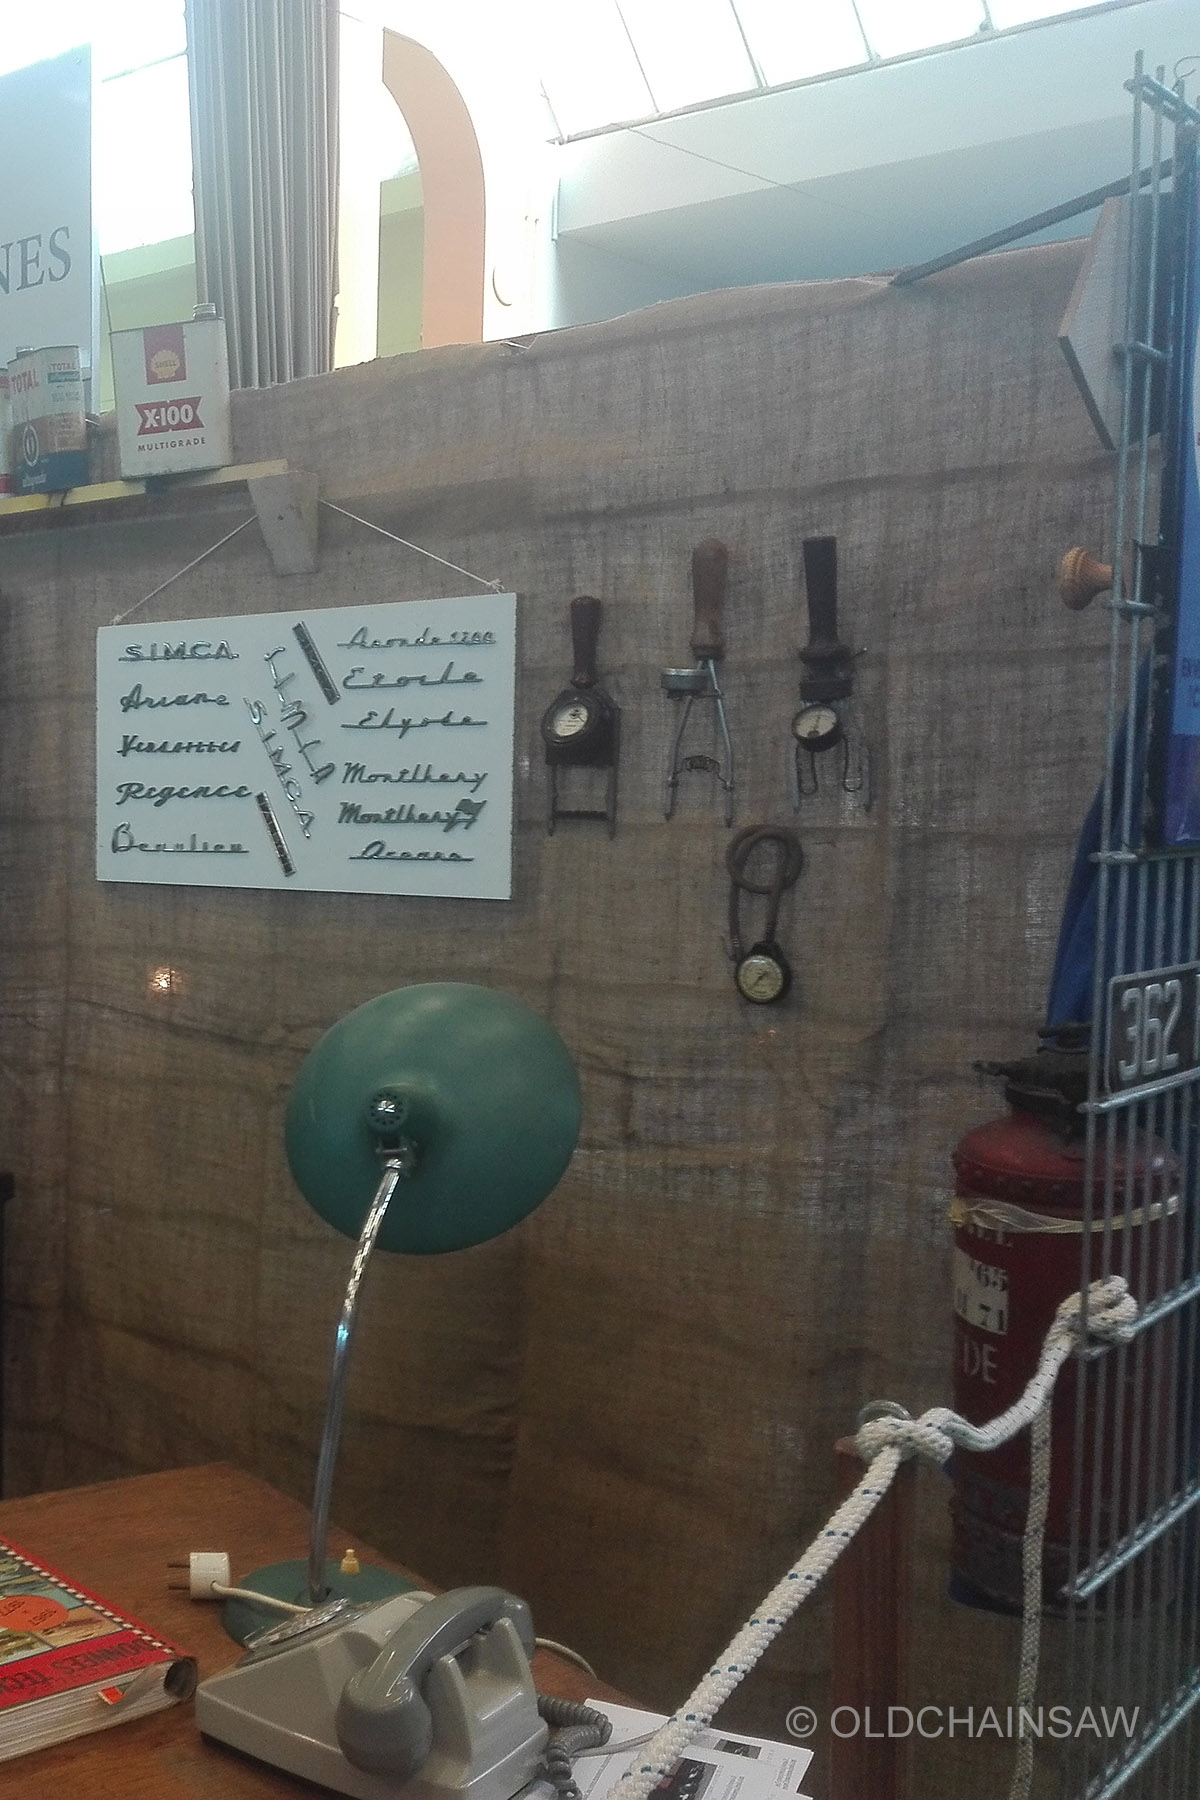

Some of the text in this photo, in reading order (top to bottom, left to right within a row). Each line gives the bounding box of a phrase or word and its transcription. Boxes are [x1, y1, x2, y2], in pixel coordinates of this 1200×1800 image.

[49, 361, 77, 371] TOTAL
[10, 368, 40, 393] TOTAL
[143, 403, 195, 428] X-100
[136, 436, 206, 452] MULTIGRADE
[118, 638, 240, 661] SIMCA
[243, 697, 314, 838] SIMCA
[1118, 978, 1182, 1081] 362
